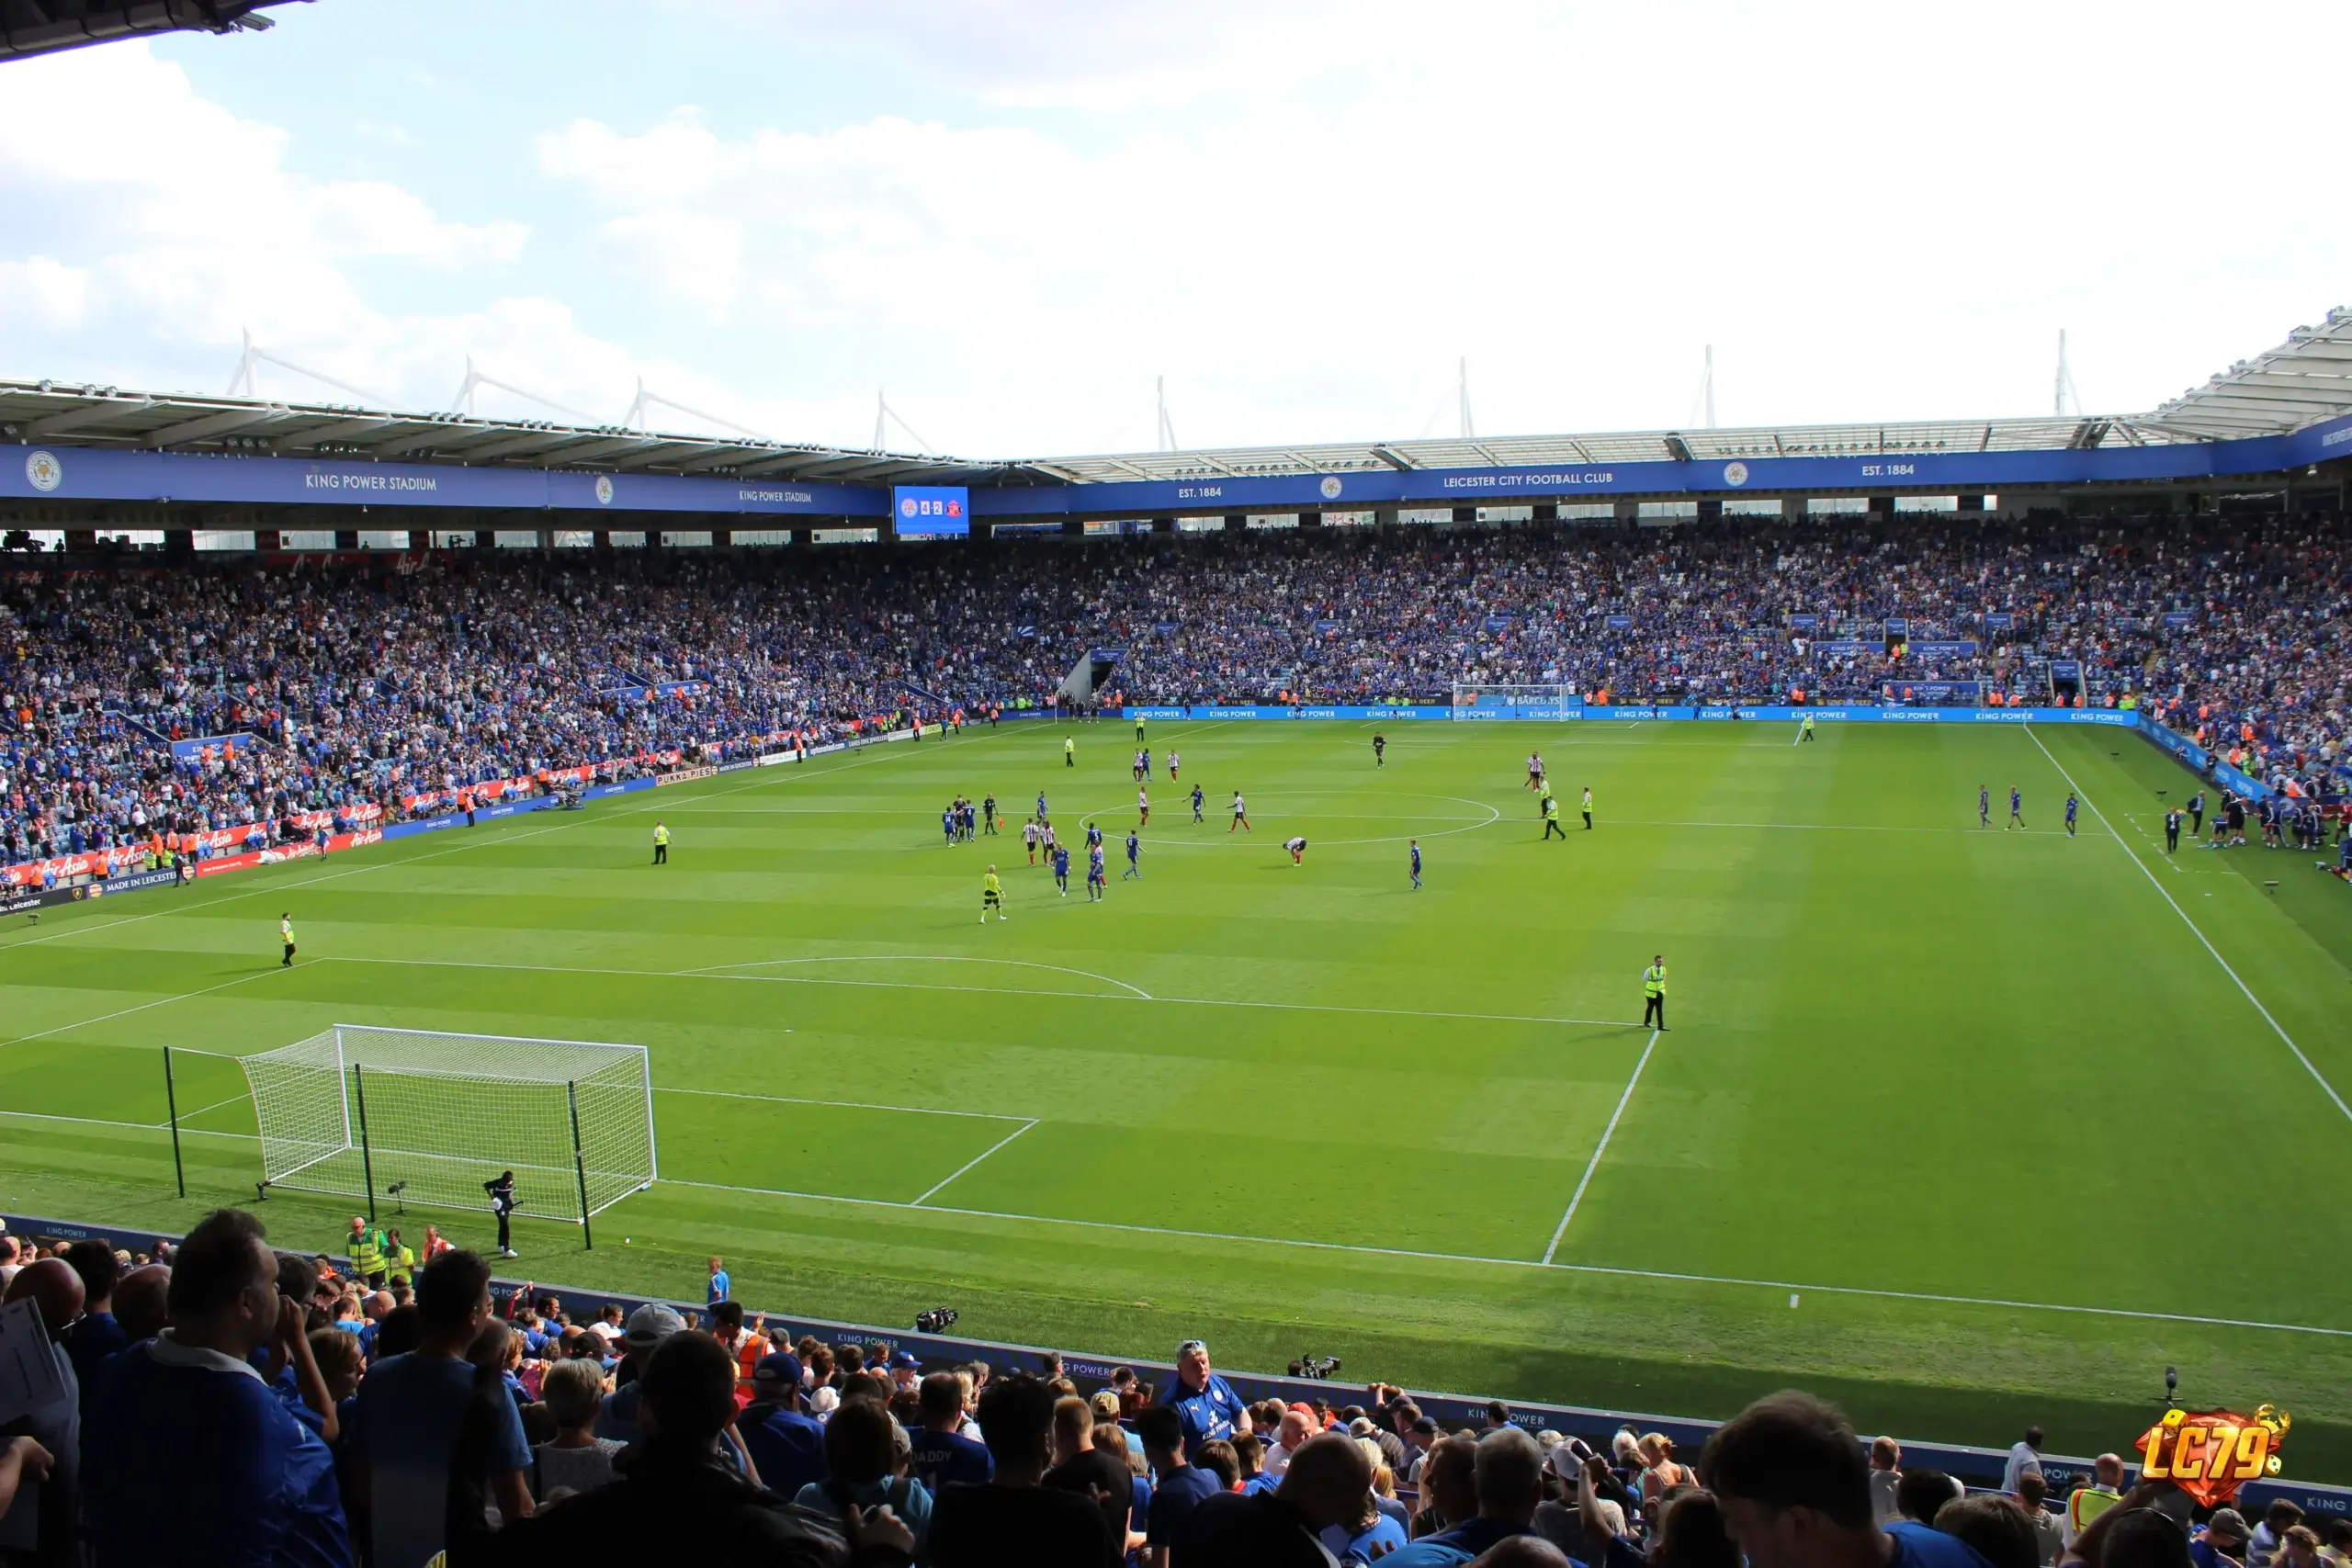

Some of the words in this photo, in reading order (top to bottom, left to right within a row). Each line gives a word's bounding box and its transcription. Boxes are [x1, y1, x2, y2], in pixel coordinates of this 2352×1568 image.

[1861, 466, 1883, 477] EST.
[1887, 464, 1915, 475] 1884
[305, 474, 340, 489] KING
[343, 476, 386, 490] POWER
[390, 478, 437, 491] STADIUM
[1443, 476, 1496, 488] LEICESTER
[1498, 475, 1523, 486] CITY
[1526, 474, 1581, 485] FOOTBALL
[1584, 473, 1613, 483] CLUB
[740, 490, 757, 501] KING
[759, 491, 784, 502] POWER
[784, 492, 811, 503] STADIUM
[1179, 489, 1196, 499] EST.
[1199, 487, 1222, 497] 1884
[1517, 696, 1560, 705] BARCLYS
[2096, 714, 2124, 722] POWER
[107, 878, 134, 892] MADE
[135, 878, 141, 886] IN
[46, 1226, 63, 1235] KING
[64, 1228, 87, 1238] POWER
[837, 1333, 863, 1345] KING
[865, 1337, 899, 1349] POWER
[1073, 1364, 1110, 1377] POWER
[1468, 1407, 1487, 1419] KIN
[1510, 1413, 1544, 1426] OWER
[2306, 1497, 2346, 1511] KING
